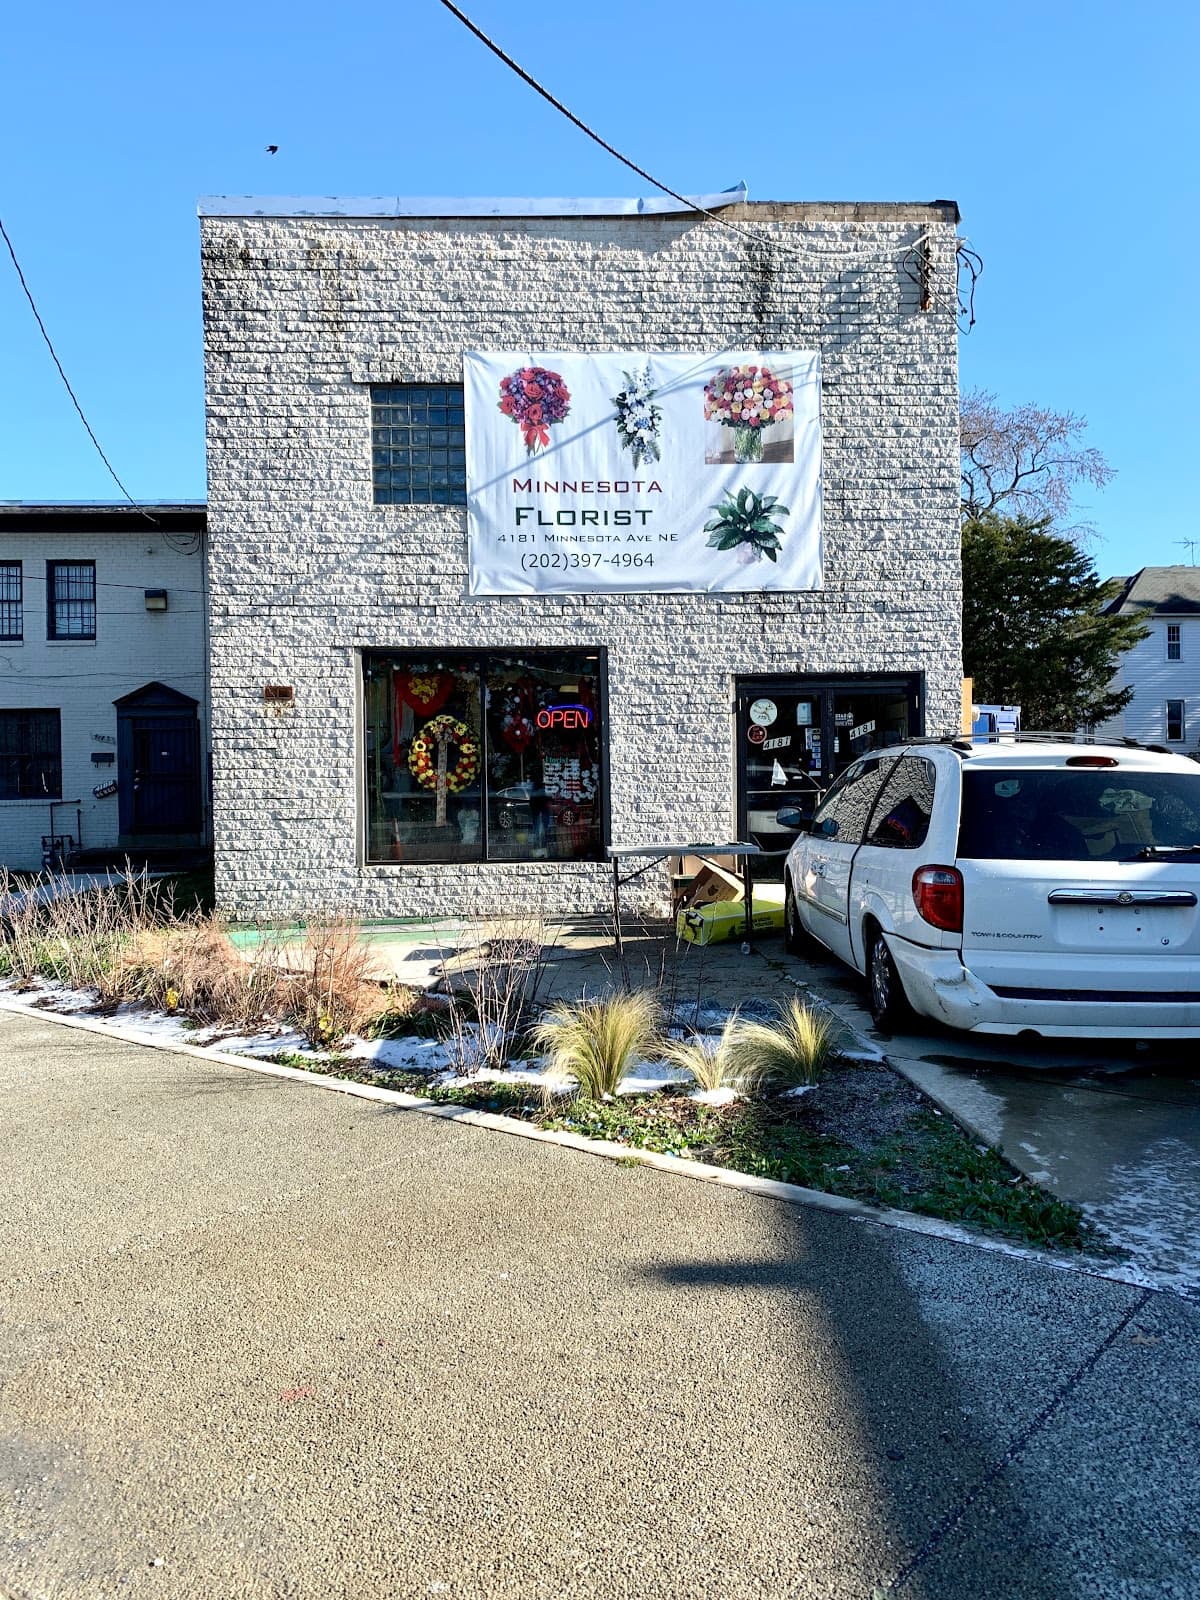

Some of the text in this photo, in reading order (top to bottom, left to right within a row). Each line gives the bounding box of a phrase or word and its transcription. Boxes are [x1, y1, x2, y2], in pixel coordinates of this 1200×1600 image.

[513, 478, 663, 494] MINNESOTA
[515, 506, 654, 526] FLORIST
[497, 533, 678, 543] 4181 MINNESOTA AVE NE
[520, 552, 655, 572] (202)397-4964
[537, 710, 589, 729] OPEN
[850, 721, 873, 738] 4181
[763, 737, 789, 749] 4181
